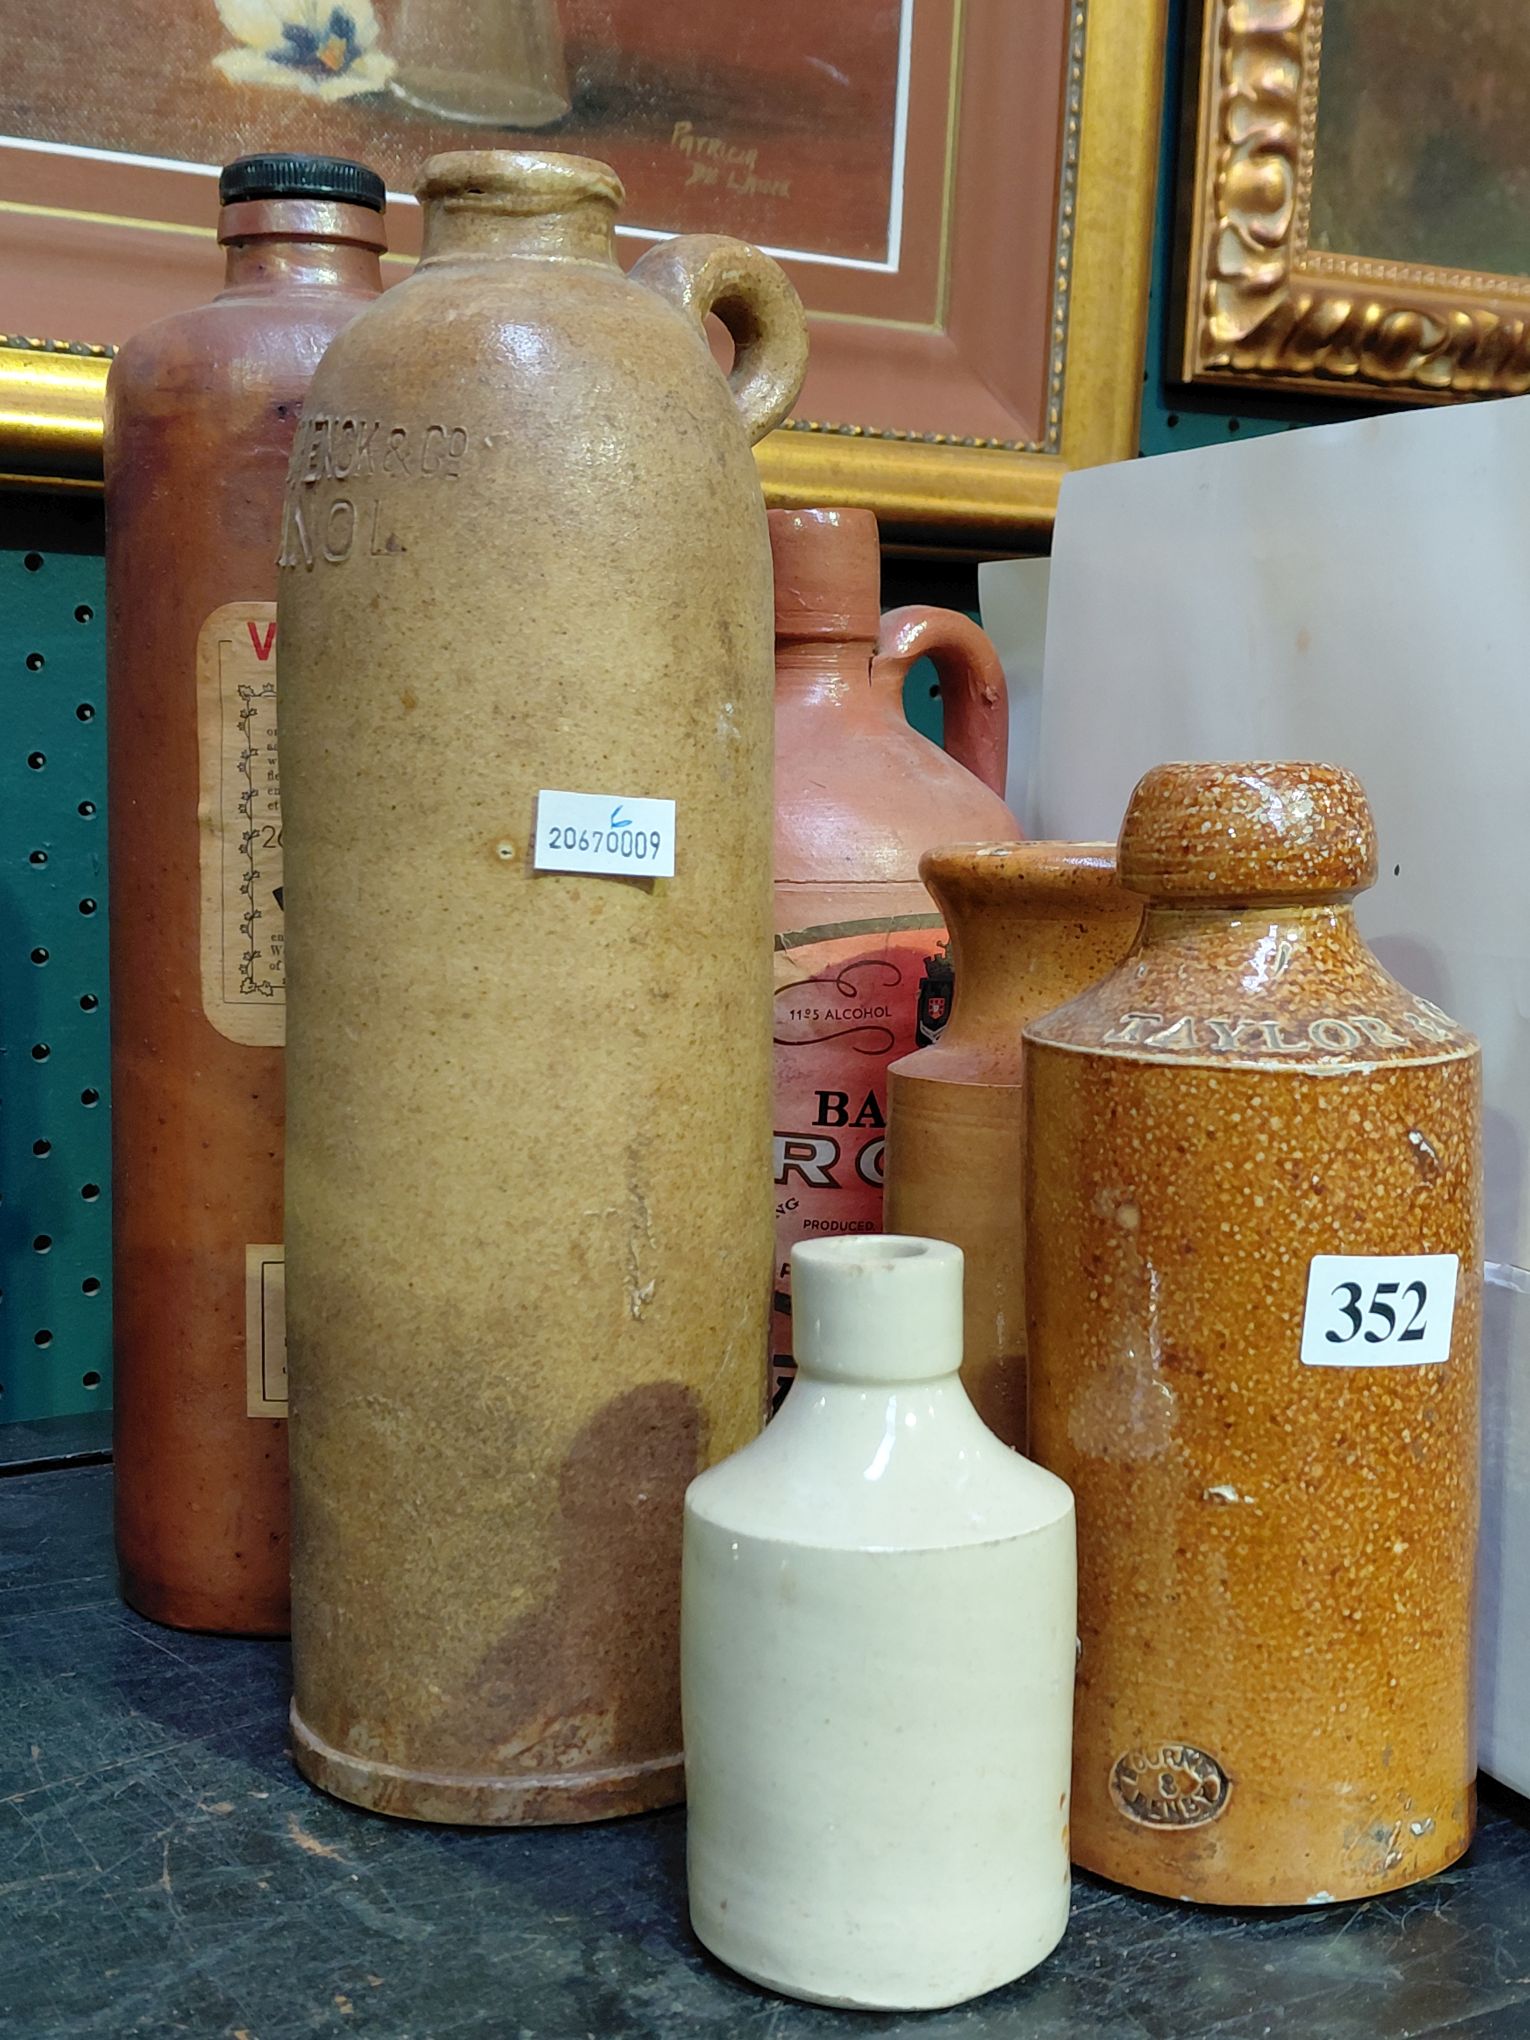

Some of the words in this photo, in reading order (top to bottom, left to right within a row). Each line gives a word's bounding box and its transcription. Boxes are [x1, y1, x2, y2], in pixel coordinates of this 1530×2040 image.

[549, 826, 661, 860] 20670009
[824, 1005, 893, 1021] ALCOHOL
[1102, 1012, 1408, 1052] TAYLOR
[1324, 1280, 1428, 1344] 352
